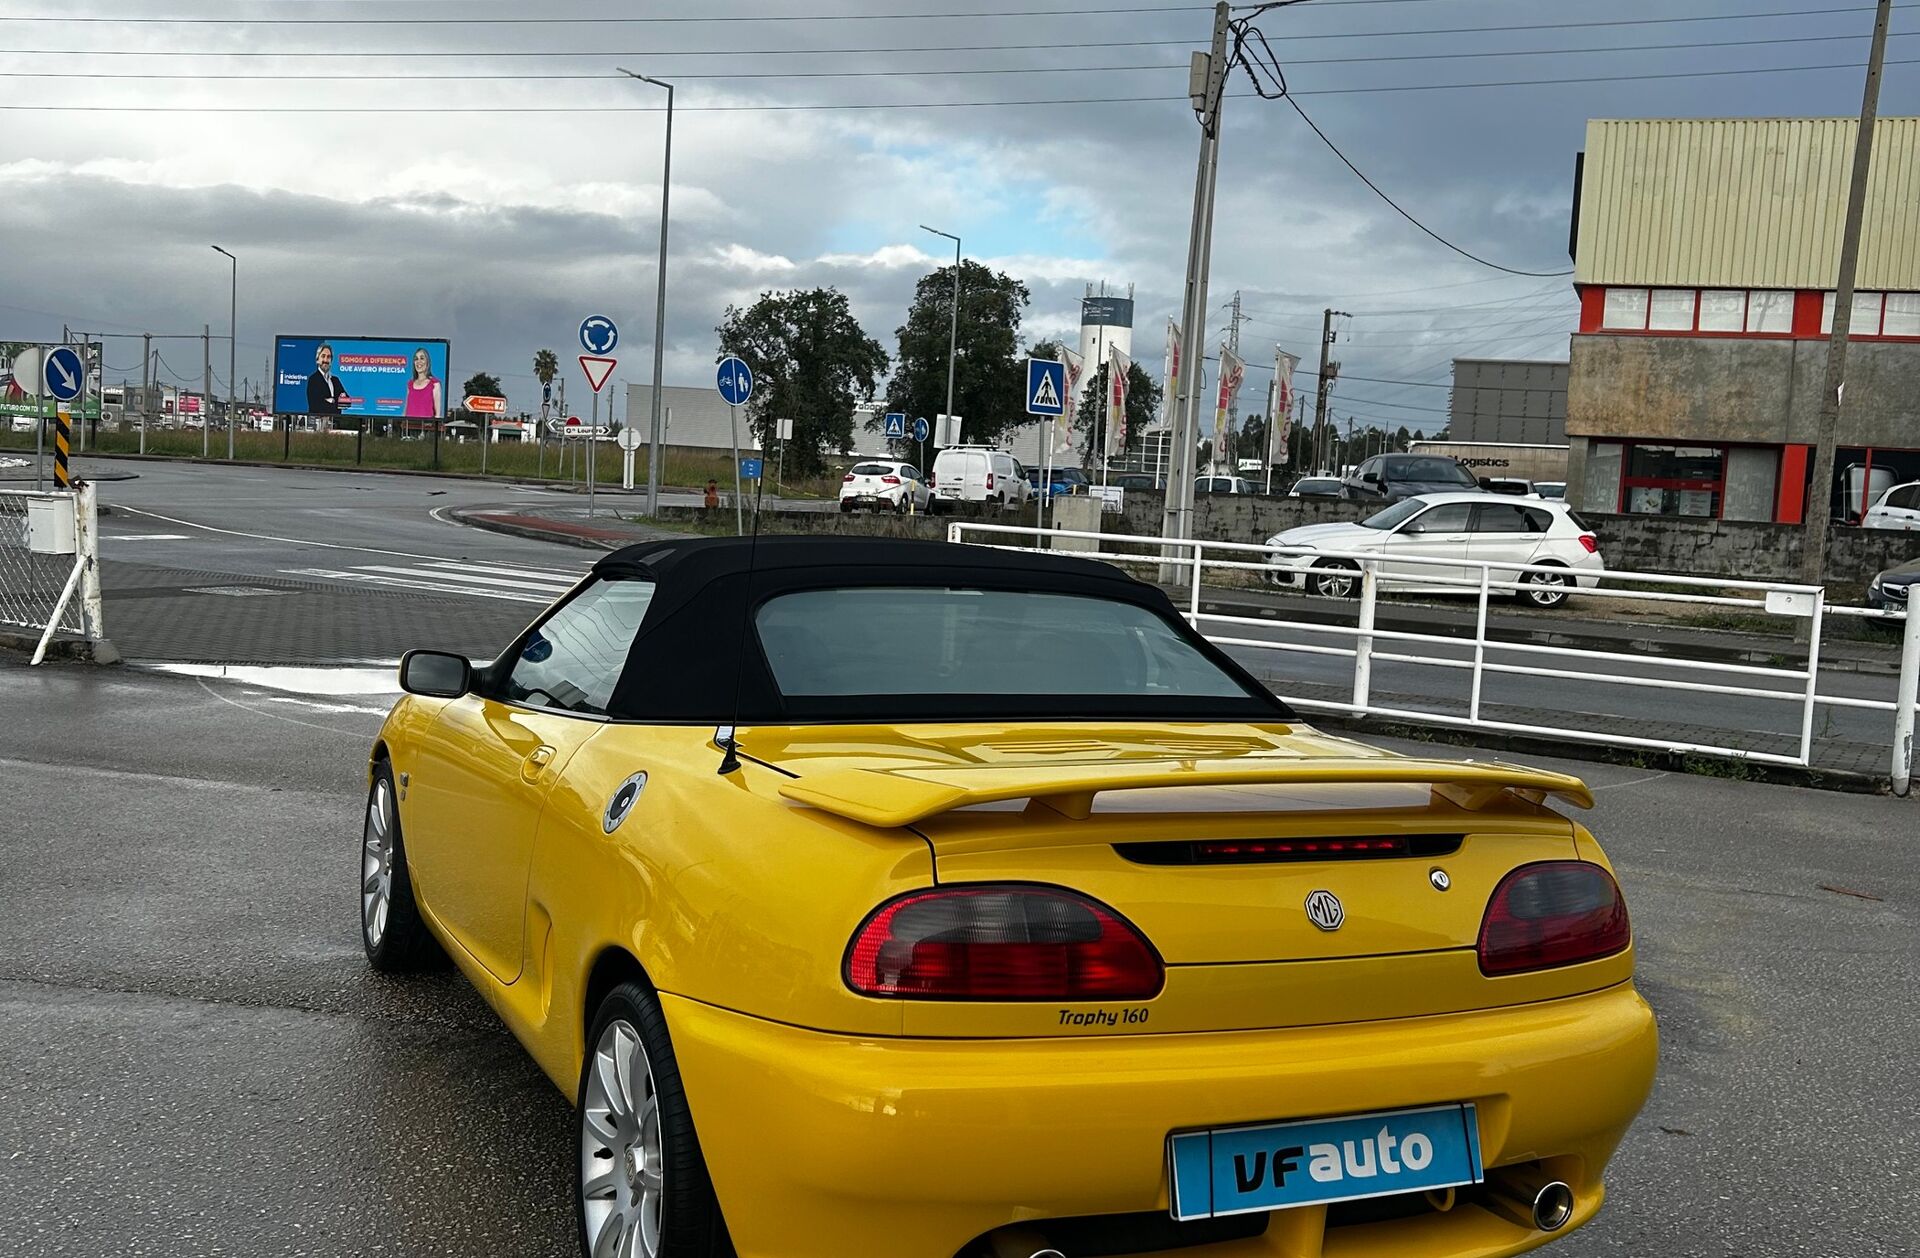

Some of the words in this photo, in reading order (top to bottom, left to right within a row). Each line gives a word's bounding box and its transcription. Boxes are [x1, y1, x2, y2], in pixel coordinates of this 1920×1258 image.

[340, 356, 363, 364] SOMOS
[370, 357, 406, 366] DIFERENÇA
[1312, 895, 1339, 923] MG
[1059, 1009, 1118, 1026] Trophy
[1122, 1008, 1149, 1023] 160
